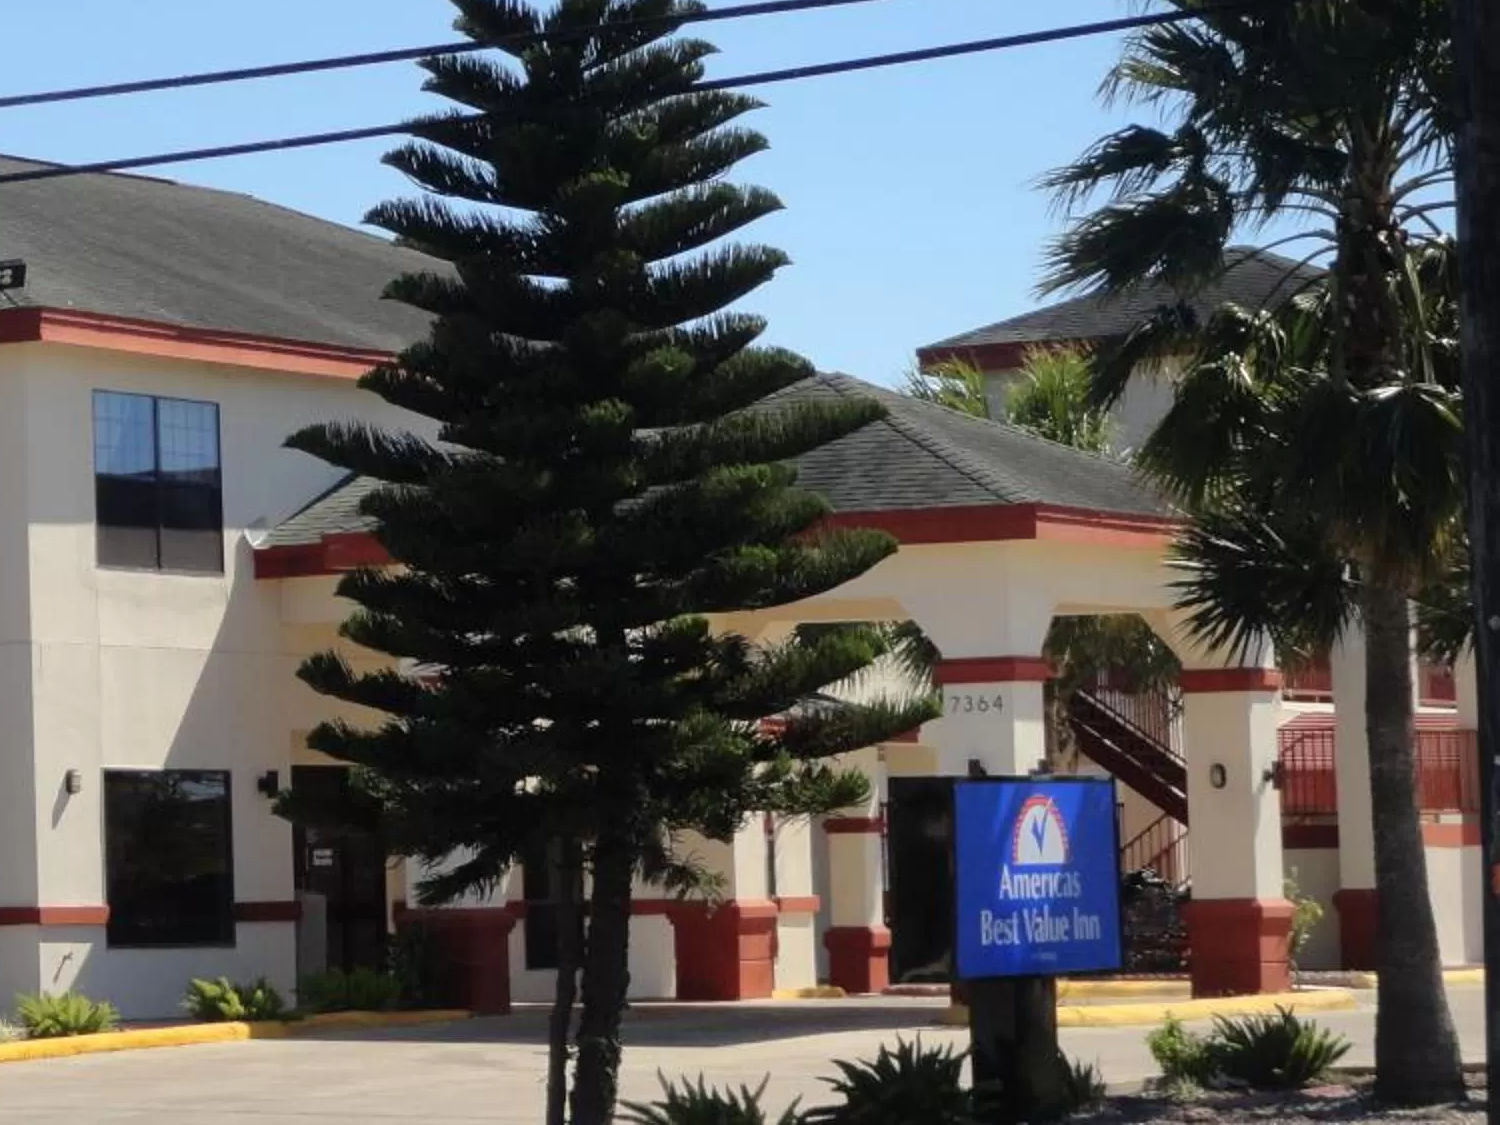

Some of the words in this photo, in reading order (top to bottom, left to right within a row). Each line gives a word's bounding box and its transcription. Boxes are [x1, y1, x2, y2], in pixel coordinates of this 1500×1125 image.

[951, 694, 1003, 713] 7364
[999, 865, 1082, 900] Americas
[980, 908, 1021, 946] Best
[1023, 904, 1069, 946] Value
[1073, 906, 1101, 941] Inn
